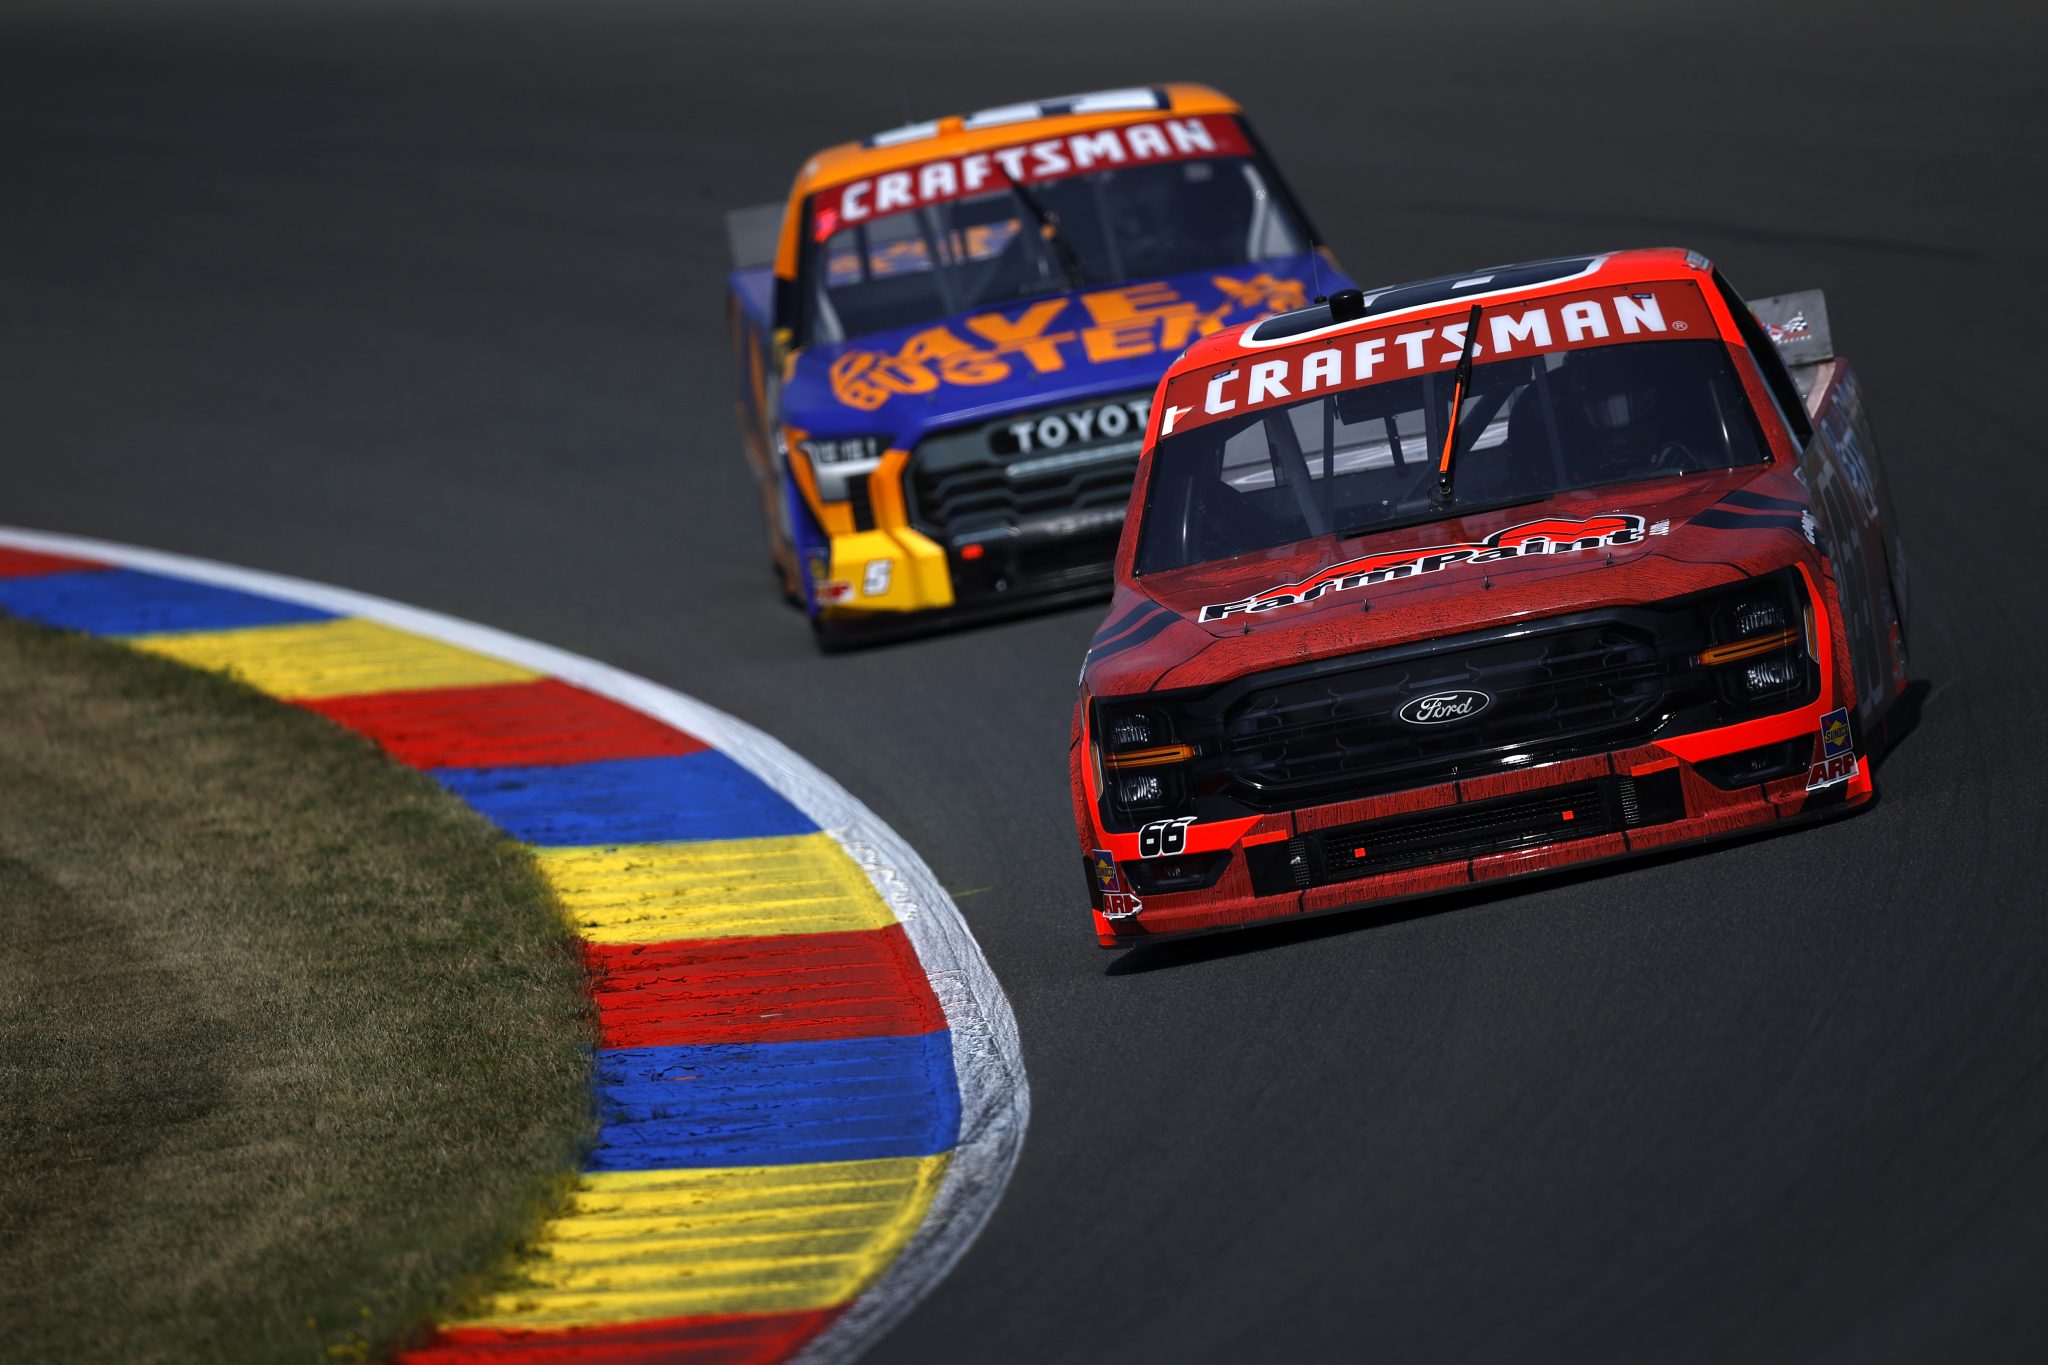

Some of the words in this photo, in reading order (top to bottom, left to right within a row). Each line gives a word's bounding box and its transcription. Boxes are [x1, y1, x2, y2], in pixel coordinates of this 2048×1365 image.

[841, 117, 1217, 223] CRAFTSMAN
[1204, 293, 1668, 415] CRAFTSMAN
[1008, 400, 1153, 454] TOYOT
[862, 559, 894, 596] 5
[1198, 524, 1645, 623] FarmPaint
[1416, 695, 1474, 721] Ford
[1808, 753, 1857, 787] ARP
[1138, 816, 1198, 859] 66
